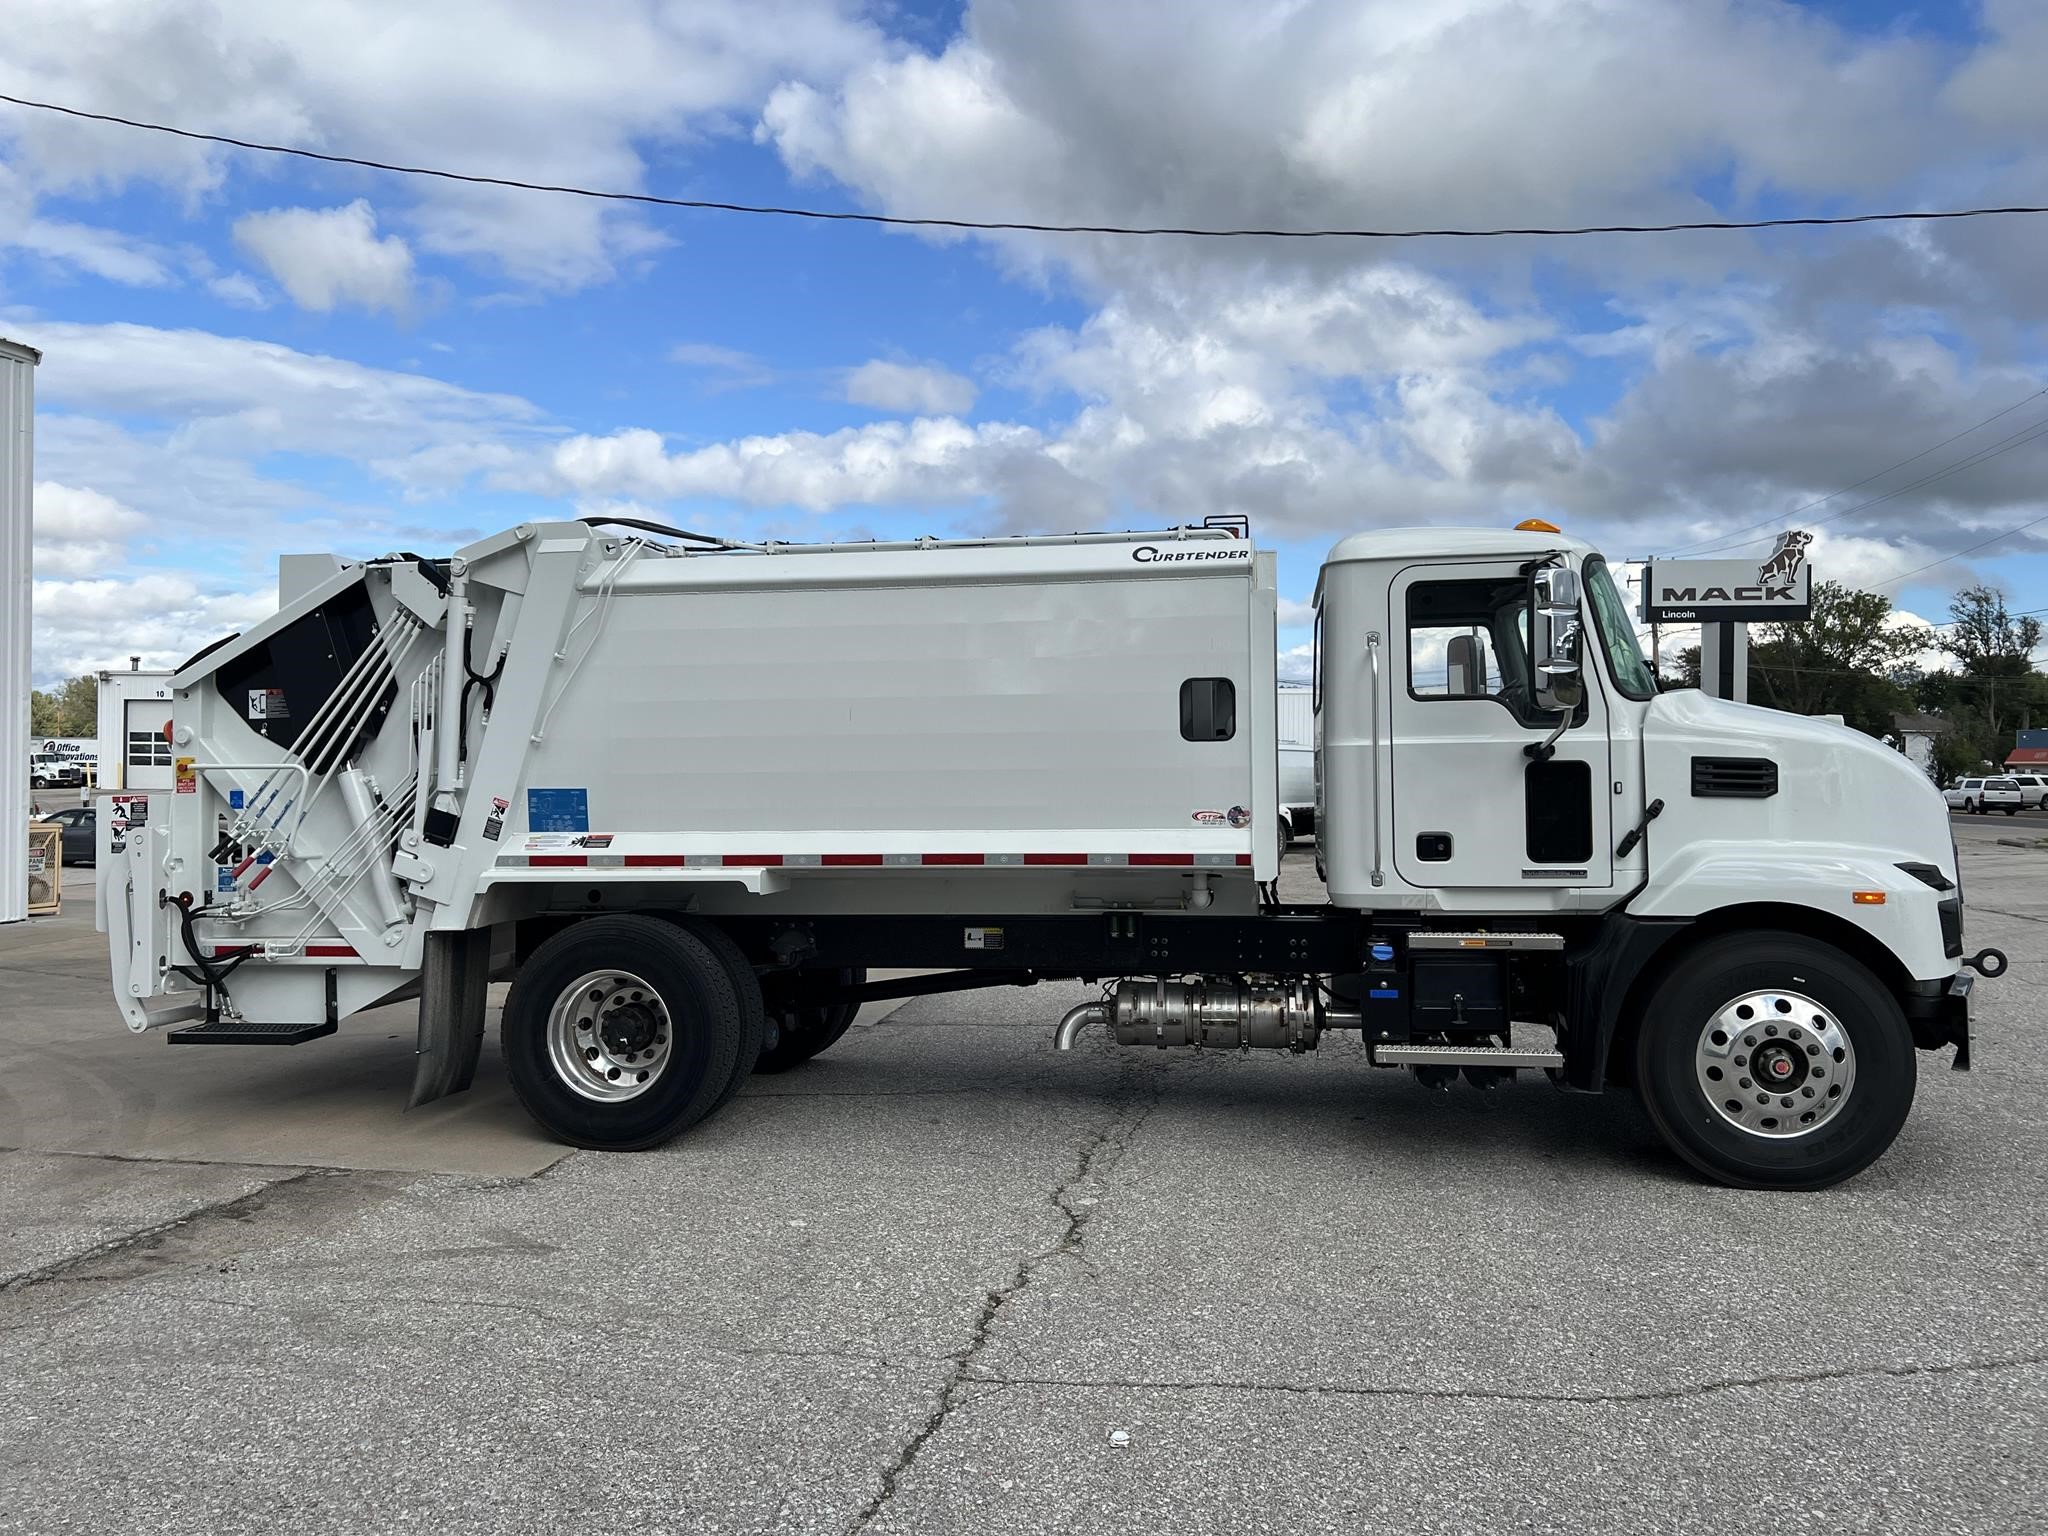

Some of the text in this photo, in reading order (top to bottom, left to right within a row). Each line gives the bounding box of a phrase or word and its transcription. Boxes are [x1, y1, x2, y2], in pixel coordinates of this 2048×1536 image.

[1132, 546, 1249, 562] CURBTENDER
[1662, 586, 1796, 601] MACK
[1662, 610, 1696, 619] Lincoln
[156, 690, 164, 698] 10
[56, 743, 81, 752] Office
[64, 752, 98, 761] ovations
